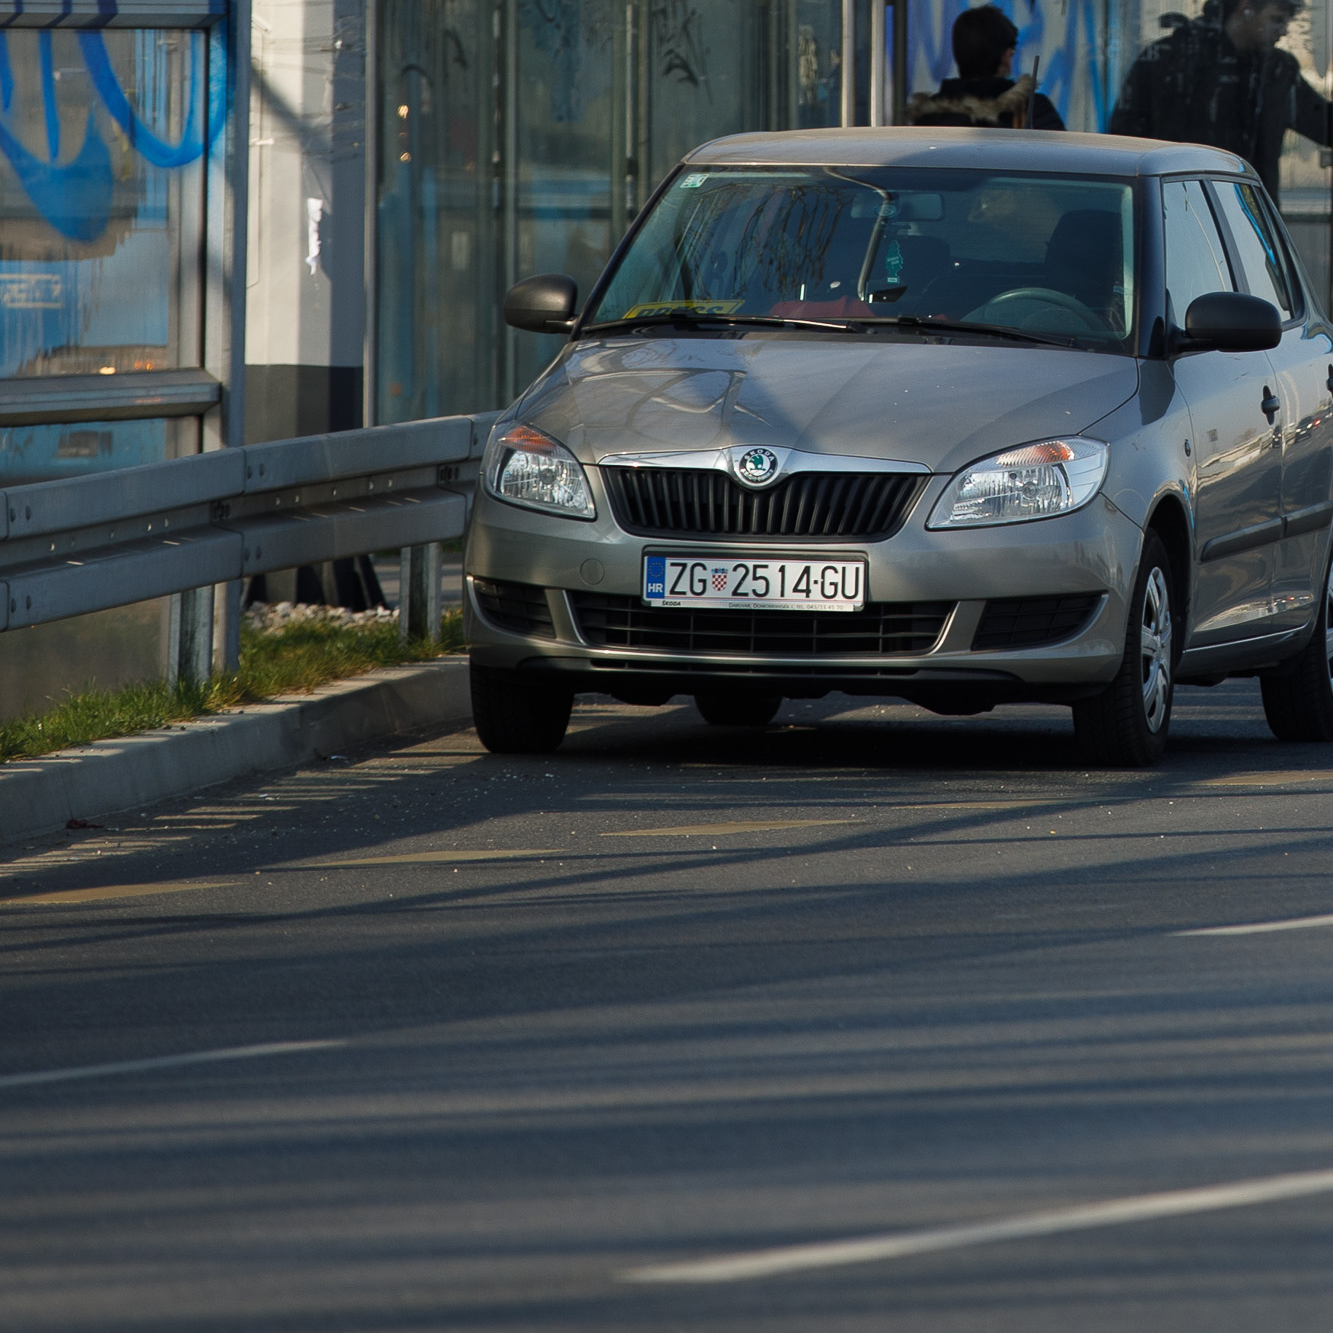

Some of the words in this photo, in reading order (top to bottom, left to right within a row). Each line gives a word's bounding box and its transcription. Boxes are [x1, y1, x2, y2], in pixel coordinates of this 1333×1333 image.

[647, 583, 663, 593] HR
[669, 562, 708, 596] ZG
[731, 563, 860, 600] 2514-GU
